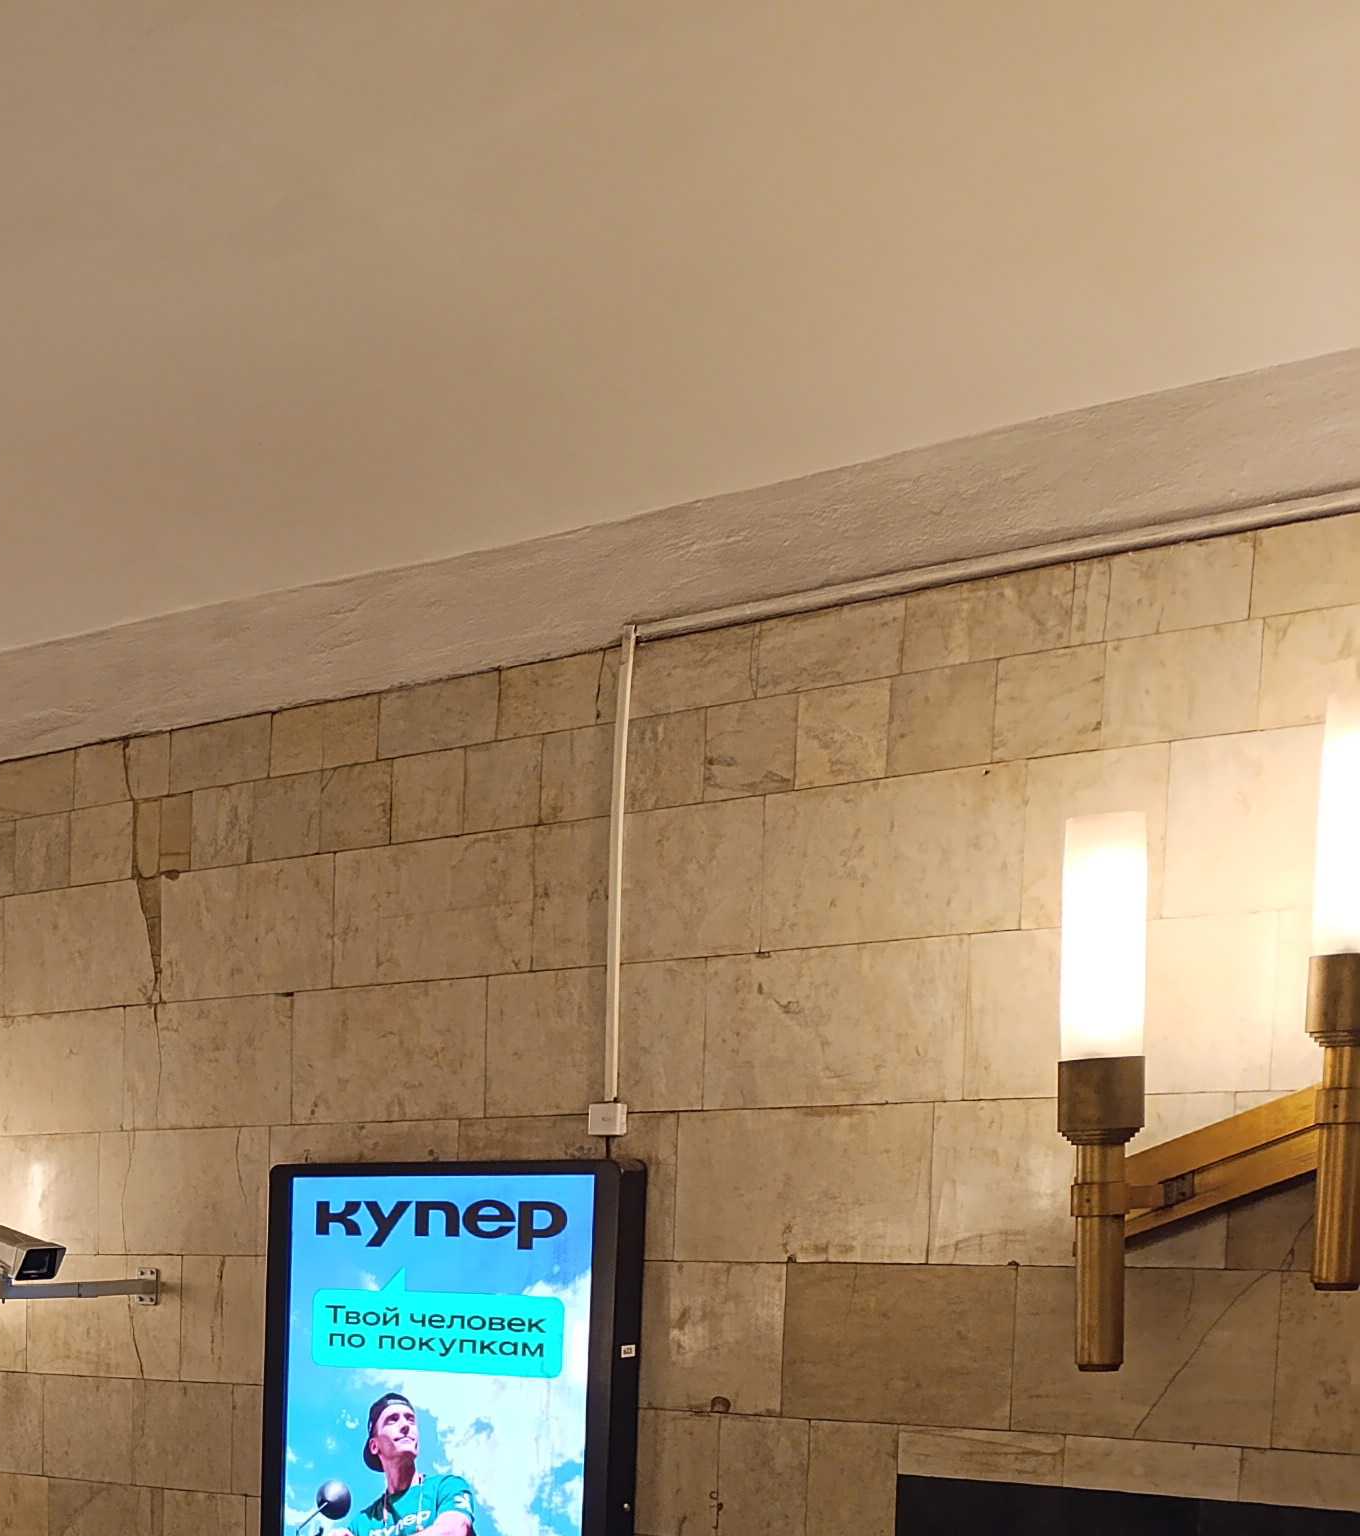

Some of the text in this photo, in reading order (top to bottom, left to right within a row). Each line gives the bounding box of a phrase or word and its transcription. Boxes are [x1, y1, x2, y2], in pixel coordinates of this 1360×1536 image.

[315, 1199, 568, 1250] купер
[325, 1304, 546, 1334] Твой человек
[328, 1333, 545, 1358] по покупкам
